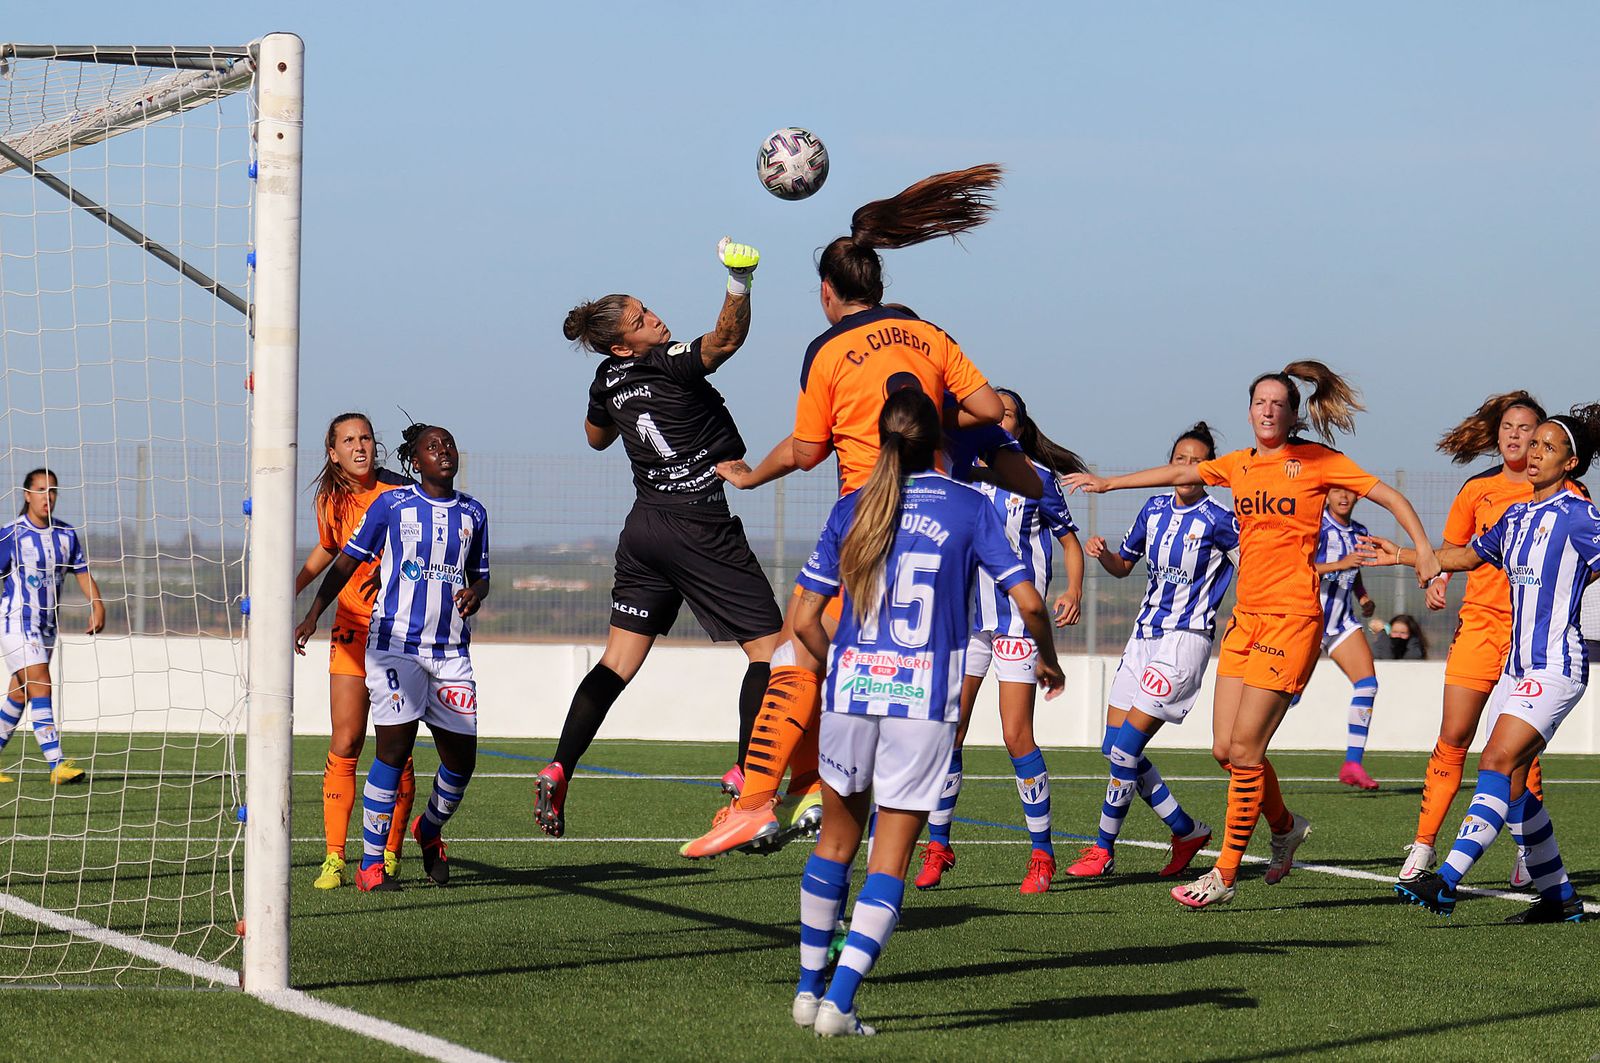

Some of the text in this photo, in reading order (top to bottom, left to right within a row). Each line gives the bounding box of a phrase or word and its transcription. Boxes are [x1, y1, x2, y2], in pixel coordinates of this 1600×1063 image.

[866, 327, 931, 356] CUBEDO
[635, 412, 678, 461] 1
[1234, 490, 1296, 516] teika
[901, 513, 950, 547] OJEDA
[423, 571, 434, 580] TE
[430, 563, 463, 575] HUELVA
[996, 640, 1025, 656] KIA
[854, 654, 931, 671] FERTINAGRO
[386, 668, 400, 690] 8
[854, 677, 925, 698] Planasa
[1142, 670, 1163, 694] KIA
